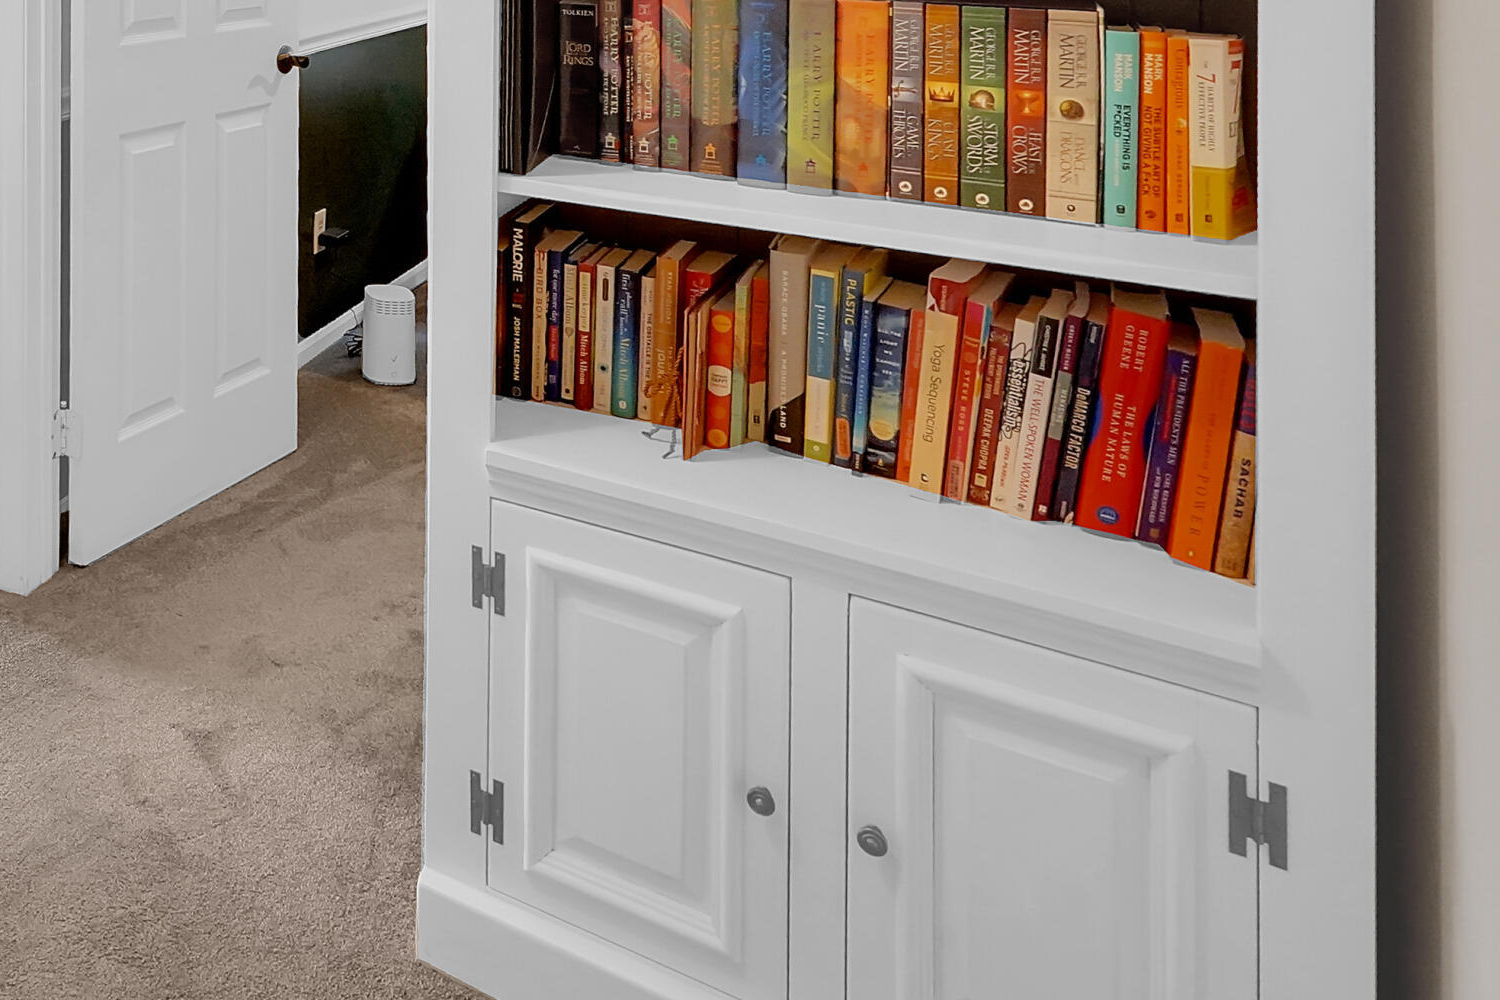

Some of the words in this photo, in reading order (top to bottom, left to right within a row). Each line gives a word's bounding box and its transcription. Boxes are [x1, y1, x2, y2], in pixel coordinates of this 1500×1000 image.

[562, 9, 594, 17] TOLKIEN
[565, 40, 592, 55] LORD
[610, 17, 620, 63] HARRY
[762, 31, 772, 81] HARRY
[812, 31, 822, 83] HARRY
[894, 19, 909, 71] MARTIN
[908, 19, 920, 57] GEORGE
[928, 24, 943, 76] MARTIN
[945, 23, 954, 61] GEORGE
[969, 26, 985, 80] MARTIN
[985, 27, 997, 63] GEORGE
[1013, 28, 1029, 84] MARTIN
[1031, 29, 1043, 67] GEORGE
[1076, 33, 1088, 71] GEORGE
[563, 54, 594, 66] RINGS
[1059, 33, 1074, 89] MARTIN
[1114, 53, 1123, 92] MANSON
[1124, 53, 1133, 79] MARK
[1143, 53, 1154, 94] MANSON
[1153, 53, 1163, 80] MARK
[1196, 73, 1216, 85] 7
[610, 68, 620, 115] POTTER
[1199, 81, 1207, 119] EFFECTIVE
[1208, 86, 1217, 112] HABITS
[811, 90, 821, 141] POTTER
[892, 109, 906, 159] THRONES
[906, 111, 919, 151] GAME
[1122, 105, 1131, 160] EVERYTHING
[1143, 106, 1152, 125] NOT
[1154, 107, 1162, 124] THE
[928, 118, 942, 161] KINGS
[943, 123, 955, 158] CLASH
[966, 114, 983, 174] SWORDS
[984, 122, 998, 167] STORM
[1012, 125, 1027, 174] CROWS
[1028, 132, 1043, 165] FEAST
[1073, 137, 1085, 172] DANCE
[1143, 128, 1152, 159] GIVING
[1153, 127, 1162, 161] SUBTLE
[1208, 124, 1217, 152] HIGHLY
[1059, 131, 1073, 184] DRAGONS
[1153, 164, 1161, 181] ART
[1153, 185, 1160, 198] OF
[512, 228, 524, 283] MALORIE
[535, 267, 543, 293] BIRD
[535, 298, 543, 320] BOX
[564, 295, 575, 324] Albom
[844, 278, 857, 326] PLASTIC
[513, 316, 521, 337] JOSH
[814, 304, 826, 344] panic
[512, 337, 521, 381] MALERMAN
[580, 334, 589, 357] Mitch
[619, 336, 631, 366] Mitch
[932, 344, 946, 373] Yoga
[1119, 325, 1136, 370] GREENE
[1134, 328, 1149, 373] ROBERT
[579, 358, 588, 385] Albom
[962, 370, 972, 400] STEVE
[1179, 375, 1189, 392] THE
[1182, 358, 1191, 375] ALL
[1003, 360, 1026, 430] essentialism
[1033, 379, 1045, 399] THE
[922, 376, 942, 444] Sequencing
[958, 405, 967, 432] ROSS
[981, 408, 994, 437] DEEPAK
[1023, 400, 1042, 458] WELL-SPOKEN
[1073, 387, 1091, 433] DeMARCO
[1109, 392, 1125, 435] HUMAN
[1127, 405, 1137, 427] THE
[977, 439, 990, 470] CHOPRA
[1063, 435, 1084, 470] FACTOR
[1101, 438, 1117, 483] NATURE
[1121, 429, 1134, 460] LAWS
[1166, 448, 1177, 466] MEN
[1017, 461, 1032, 501] WOMAN
[1118, 464, 1128, 479] OF
[1232, 458, 1252, 519] SACHAR
[1158, 487, 1171, 523] BERNSTEIN
[1188, 473, 1211, 537] POWER
